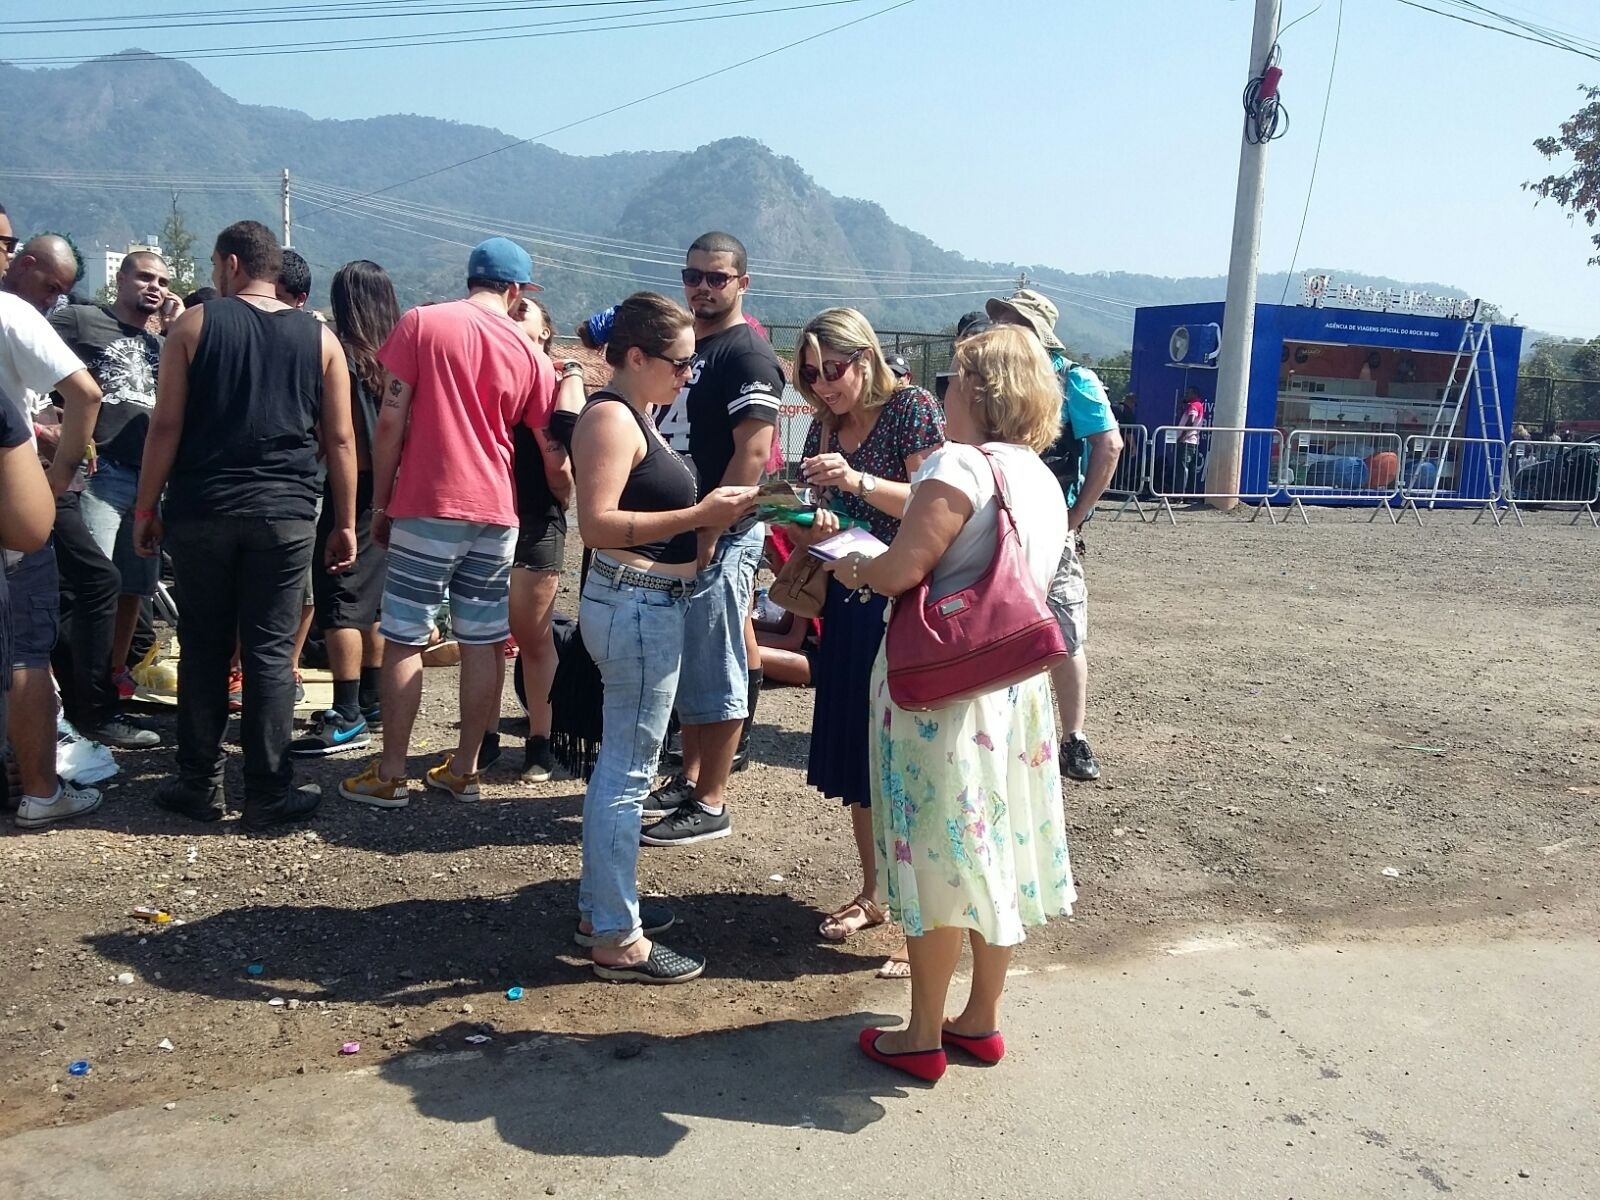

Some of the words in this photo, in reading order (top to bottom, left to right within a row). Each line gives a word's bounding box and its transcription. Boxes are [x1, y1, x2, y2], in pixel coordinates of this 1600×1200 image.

[1325, 322, 1348, 330] AGÊNCIA
[1357, 325, 1379, 333] VIAGENS
[1379, 326, 1400, 334] OFICIAL
